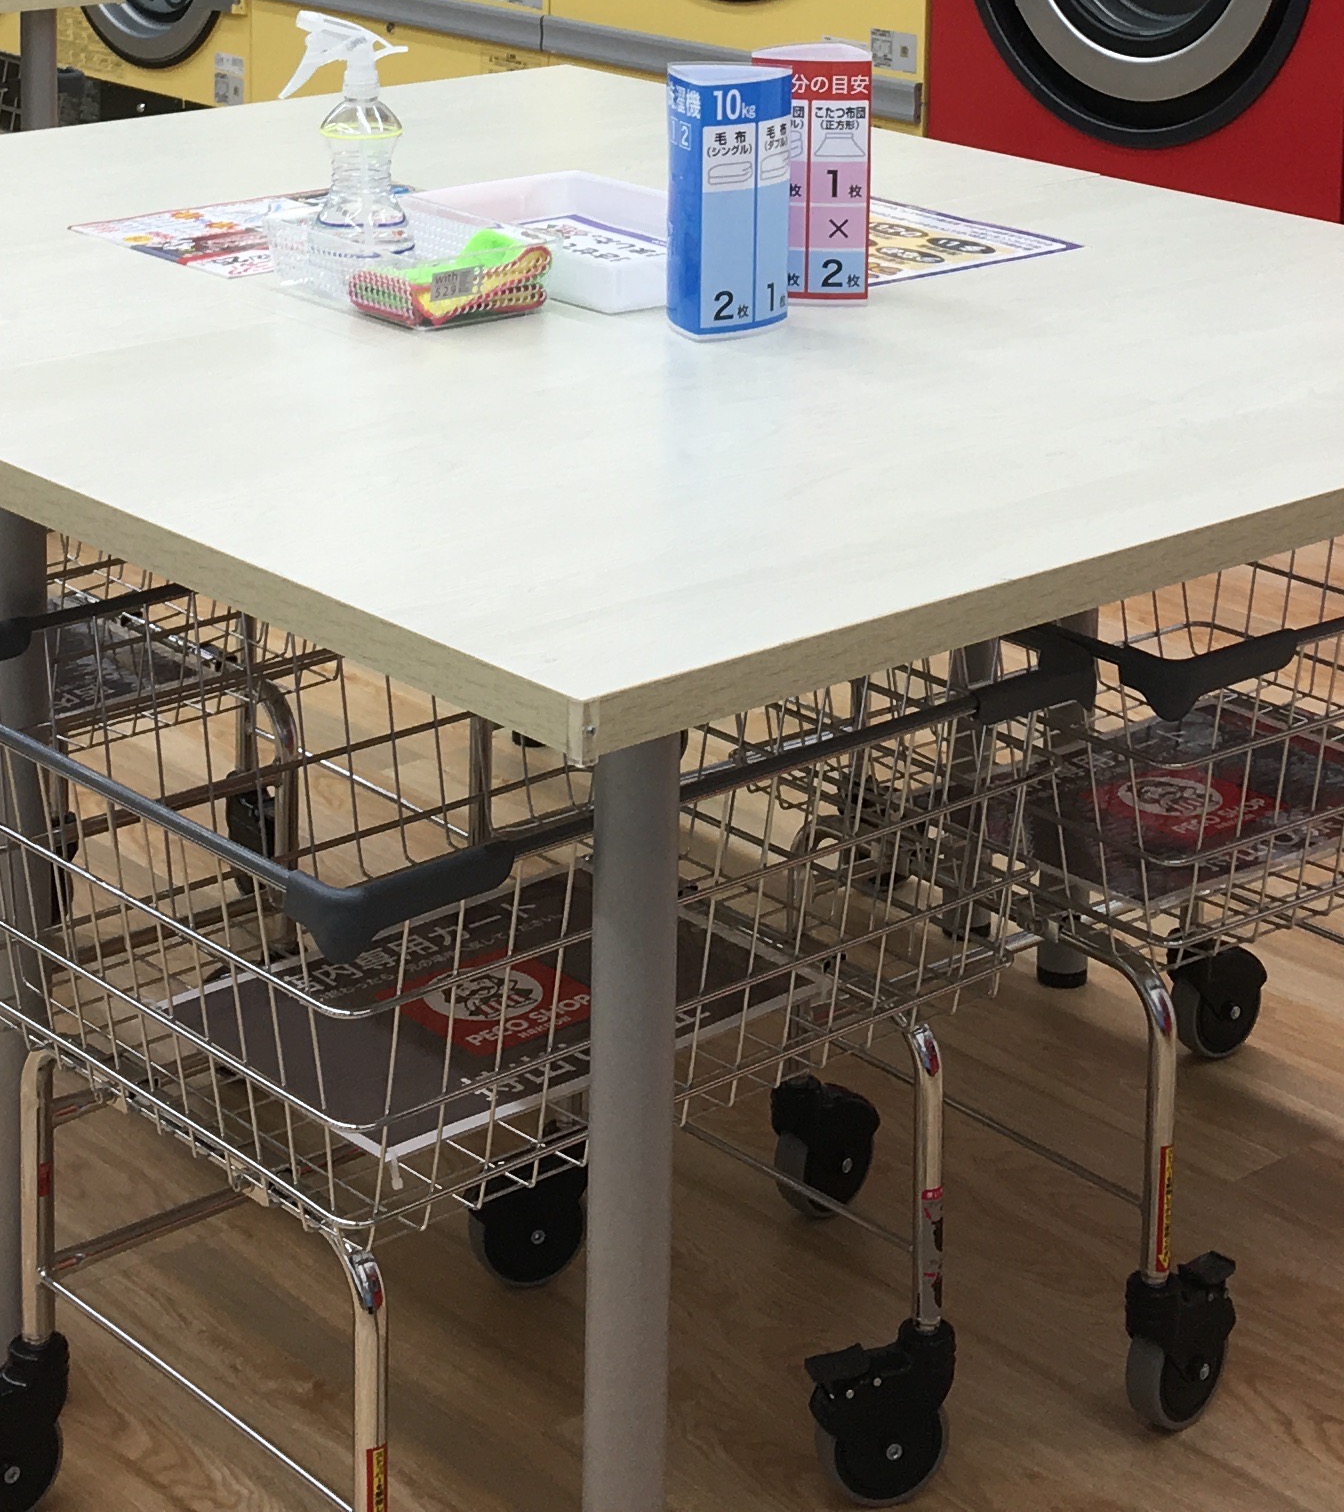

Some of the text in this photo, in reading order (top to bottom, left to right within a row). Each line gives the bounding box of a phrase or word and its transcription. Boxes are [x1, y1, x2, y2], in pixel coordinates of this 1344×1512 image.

[792, 75, 869, 94] 分の目安
[815, 107, 866, 119] こたつ布団
[435, 271, 458, 286] with
